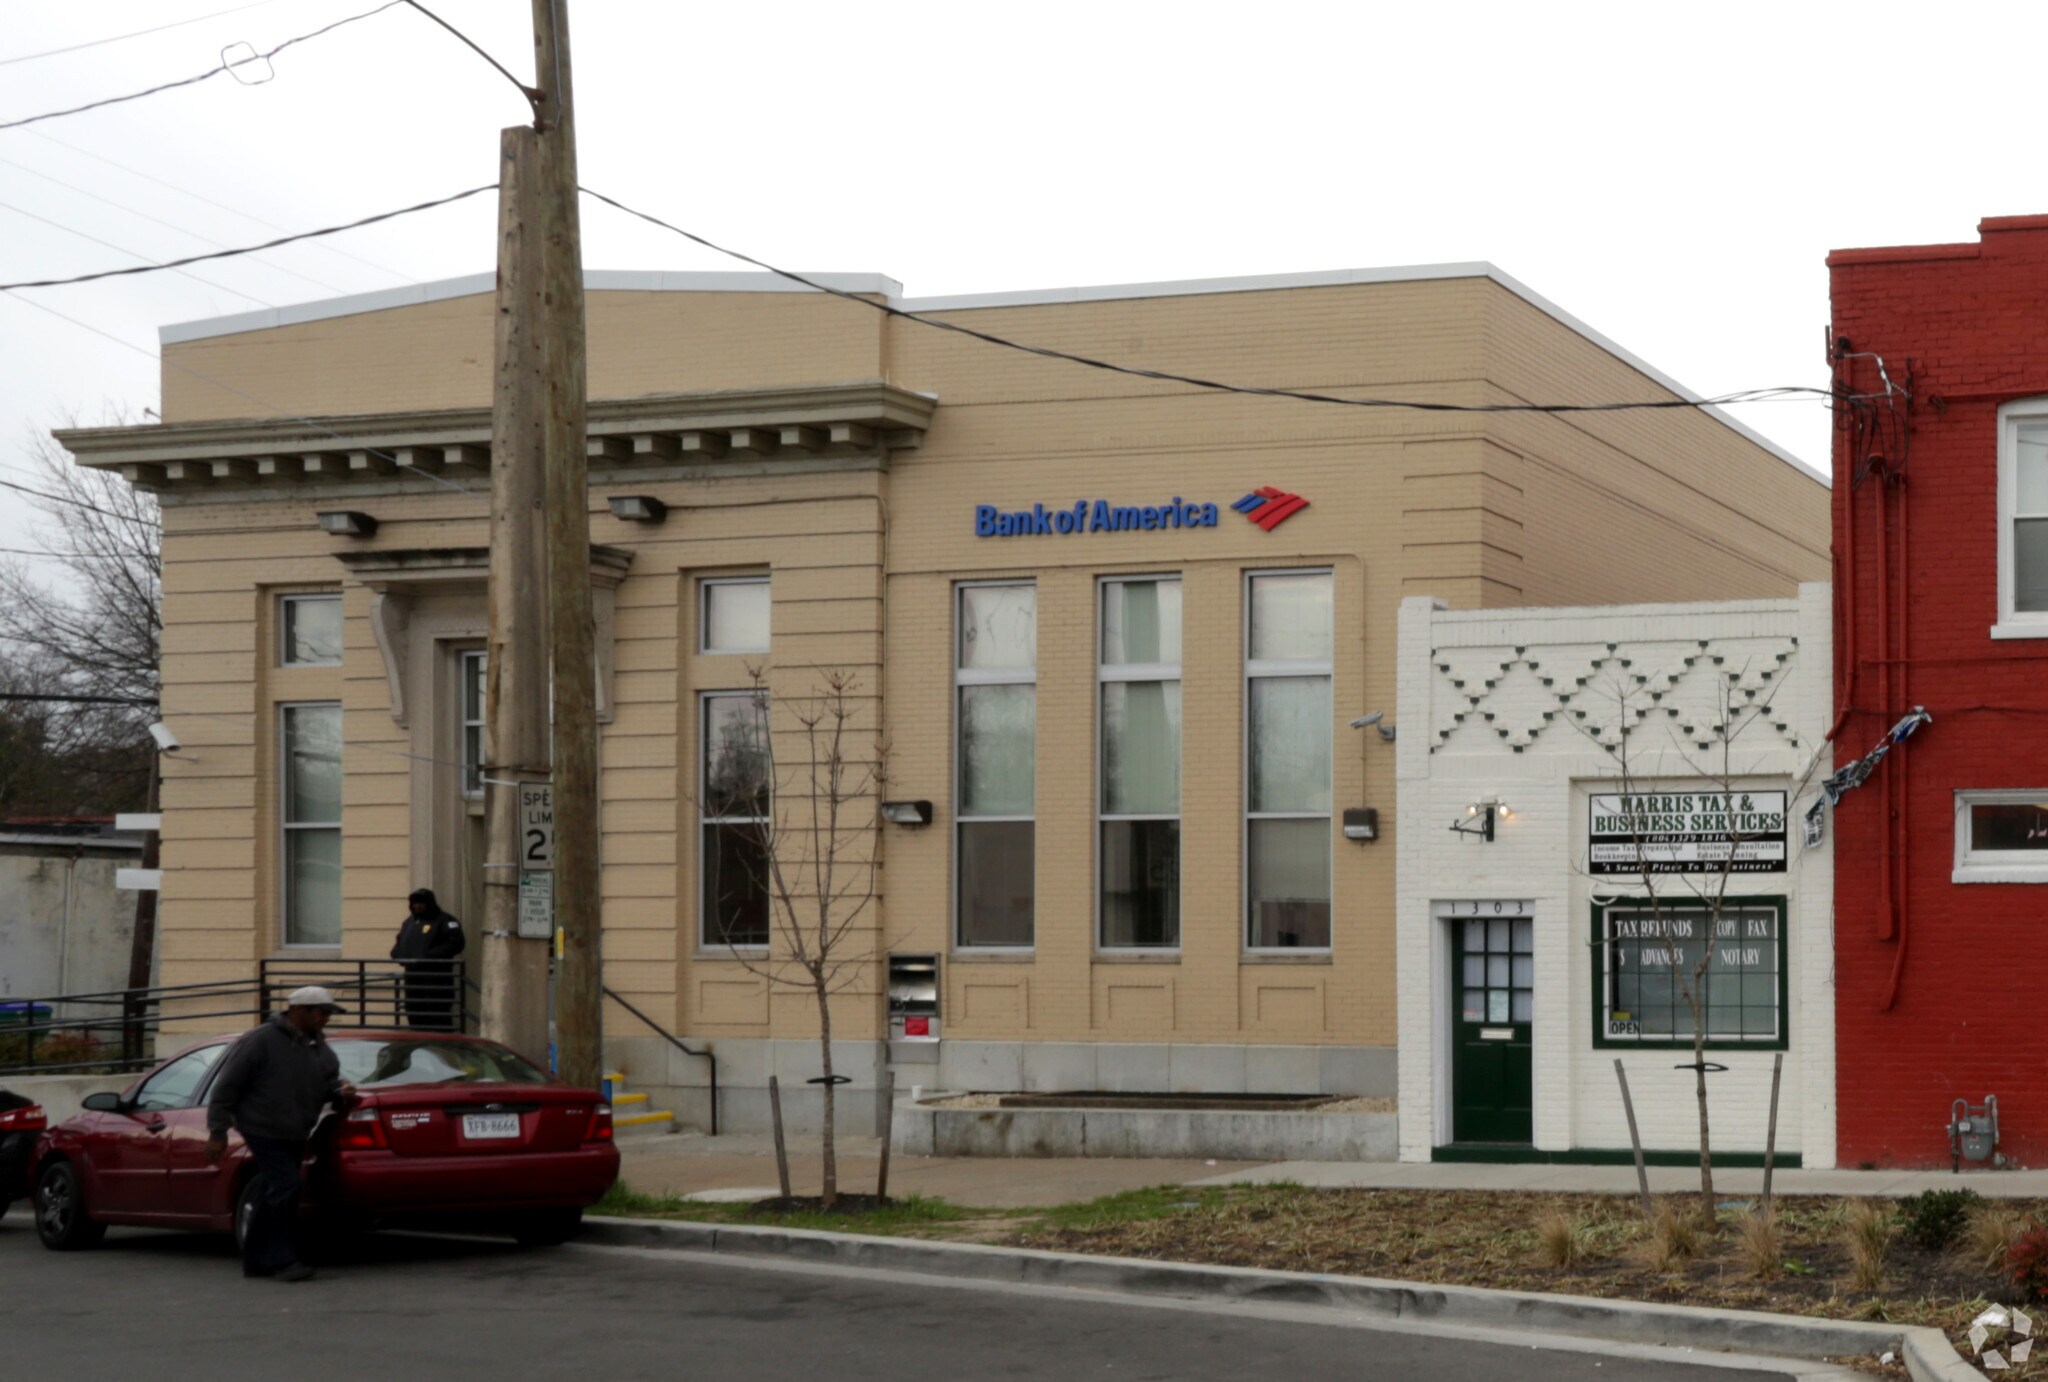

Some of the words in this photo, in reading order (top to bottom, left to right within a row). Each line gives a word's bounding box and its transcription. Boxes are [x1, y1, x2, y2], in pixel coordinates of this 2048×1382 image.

[976, 503, 1052, 537] Bank
[1054, 500, 1087, 534] of
[1089, 496, 1219, 533] America
[524, 792, 551, 807] SPE
[1621, 795, 1693, 813] HARRIS
[1699, 795, 1734, 812] TAX
[1741, 794, 1754, 812] &
[529, 811, 553, 825] LIM
[1595, 814, 1686, 833] BUSINESS
[1690, 812, 1782, 832] SERVICES
[527, 828, 555, 861] 2
[1594, 844, 1620, 852] Income
[1623, 844, 1635, 852] Tax
[1734, 841, 1781, 850] onsultation
[1723, 851, 1758, 861] Plnning
[1616, 863, 1643, 872] Smar
[1687, 863, 1700, 871] To
[1705, 863, 1719, 871] Do
[1729, 861, 1777, 871] usiness"
[1450, 901, 1524, 915] 1303
[1615, 920, 1638, 938] TAX
[1716, 920, 1737, 937] COPY
[1748, 919, 1768, 937] FAX
[1721, 948, 1760, 966] NOTARY
[1611, 1021, 1640, 1035] OPEN
